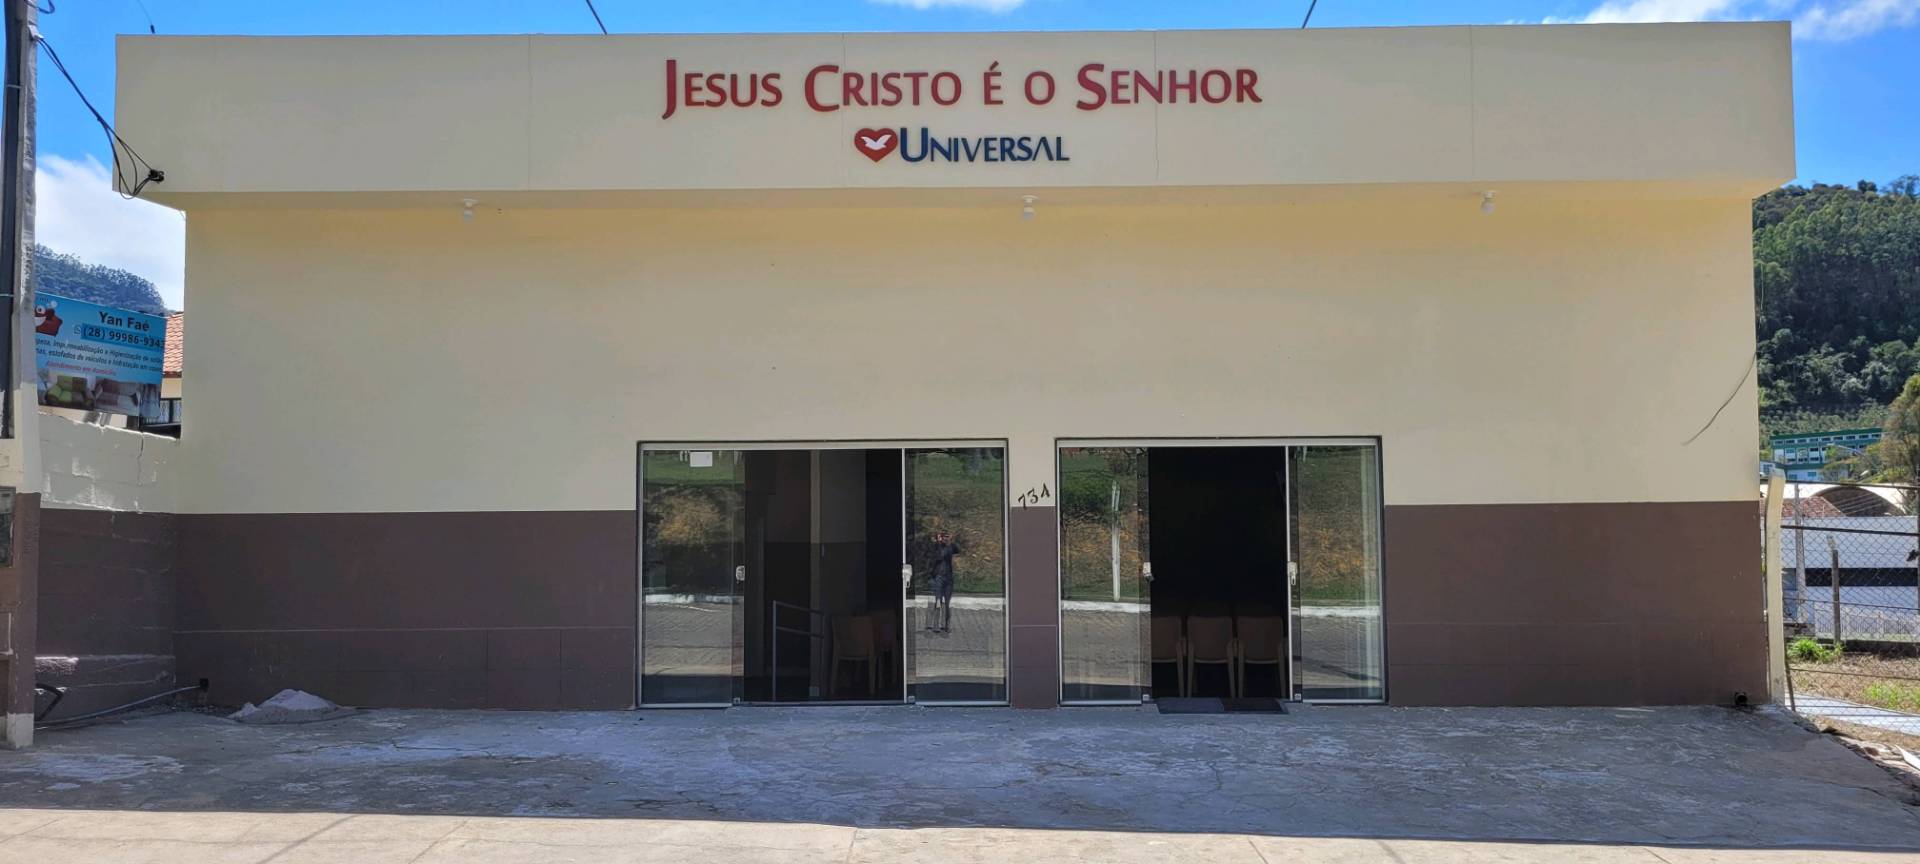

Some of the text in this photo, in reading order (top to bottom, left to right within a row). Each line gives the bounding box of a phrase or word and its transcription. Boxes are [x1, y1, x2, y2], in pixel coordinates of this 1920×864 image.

[662, 59, 1263, 120] JESUS CRISTO É O SENHOR
[900, 127, 1070, 162] UNIVERSAL
[83, 326, 105, 340] (28)
[99, 311, 150, 332] Yan Faé
